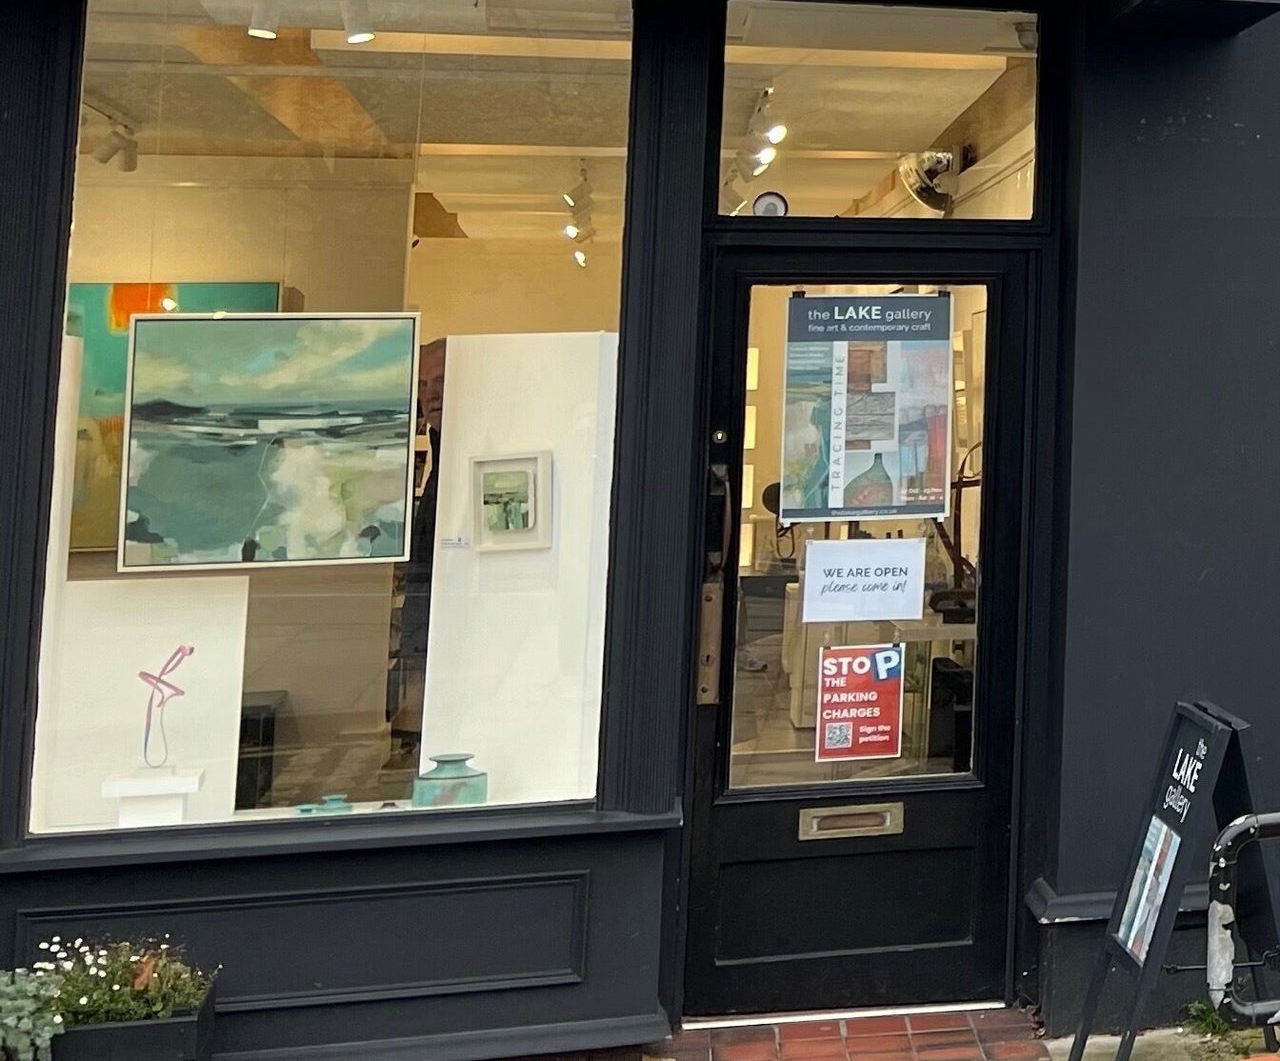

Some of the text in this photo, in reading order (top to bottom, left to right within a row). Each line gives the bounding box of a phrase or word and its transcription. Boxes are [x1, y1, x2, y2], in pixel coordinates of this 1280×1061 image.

[807, 306, 932, 322] the LAKE gallery
[808, 324, 824, 332] fine
[826, 324, 839, 332] art
[848, 323, 909, 333] contemporary
[911, 323, 931, 331] craft
[832, 354, 845, 492] TRACING TIME
[823, 567, 908, 578] WE ARE OPEN
[820, 580, 858, 596] please
[862, 582, 889, 592] come
[824, 676, 847, 687] THE
[823, 691, 878, 704] PARKING
[822, 707, 880, 719] CHARGES
[858, 734, 890, 744] petition
[1196, 738, 1208, 760] the
[1171, 748, 1203, 793] LAKE
[1163, 785, 1192, 824] gallery
